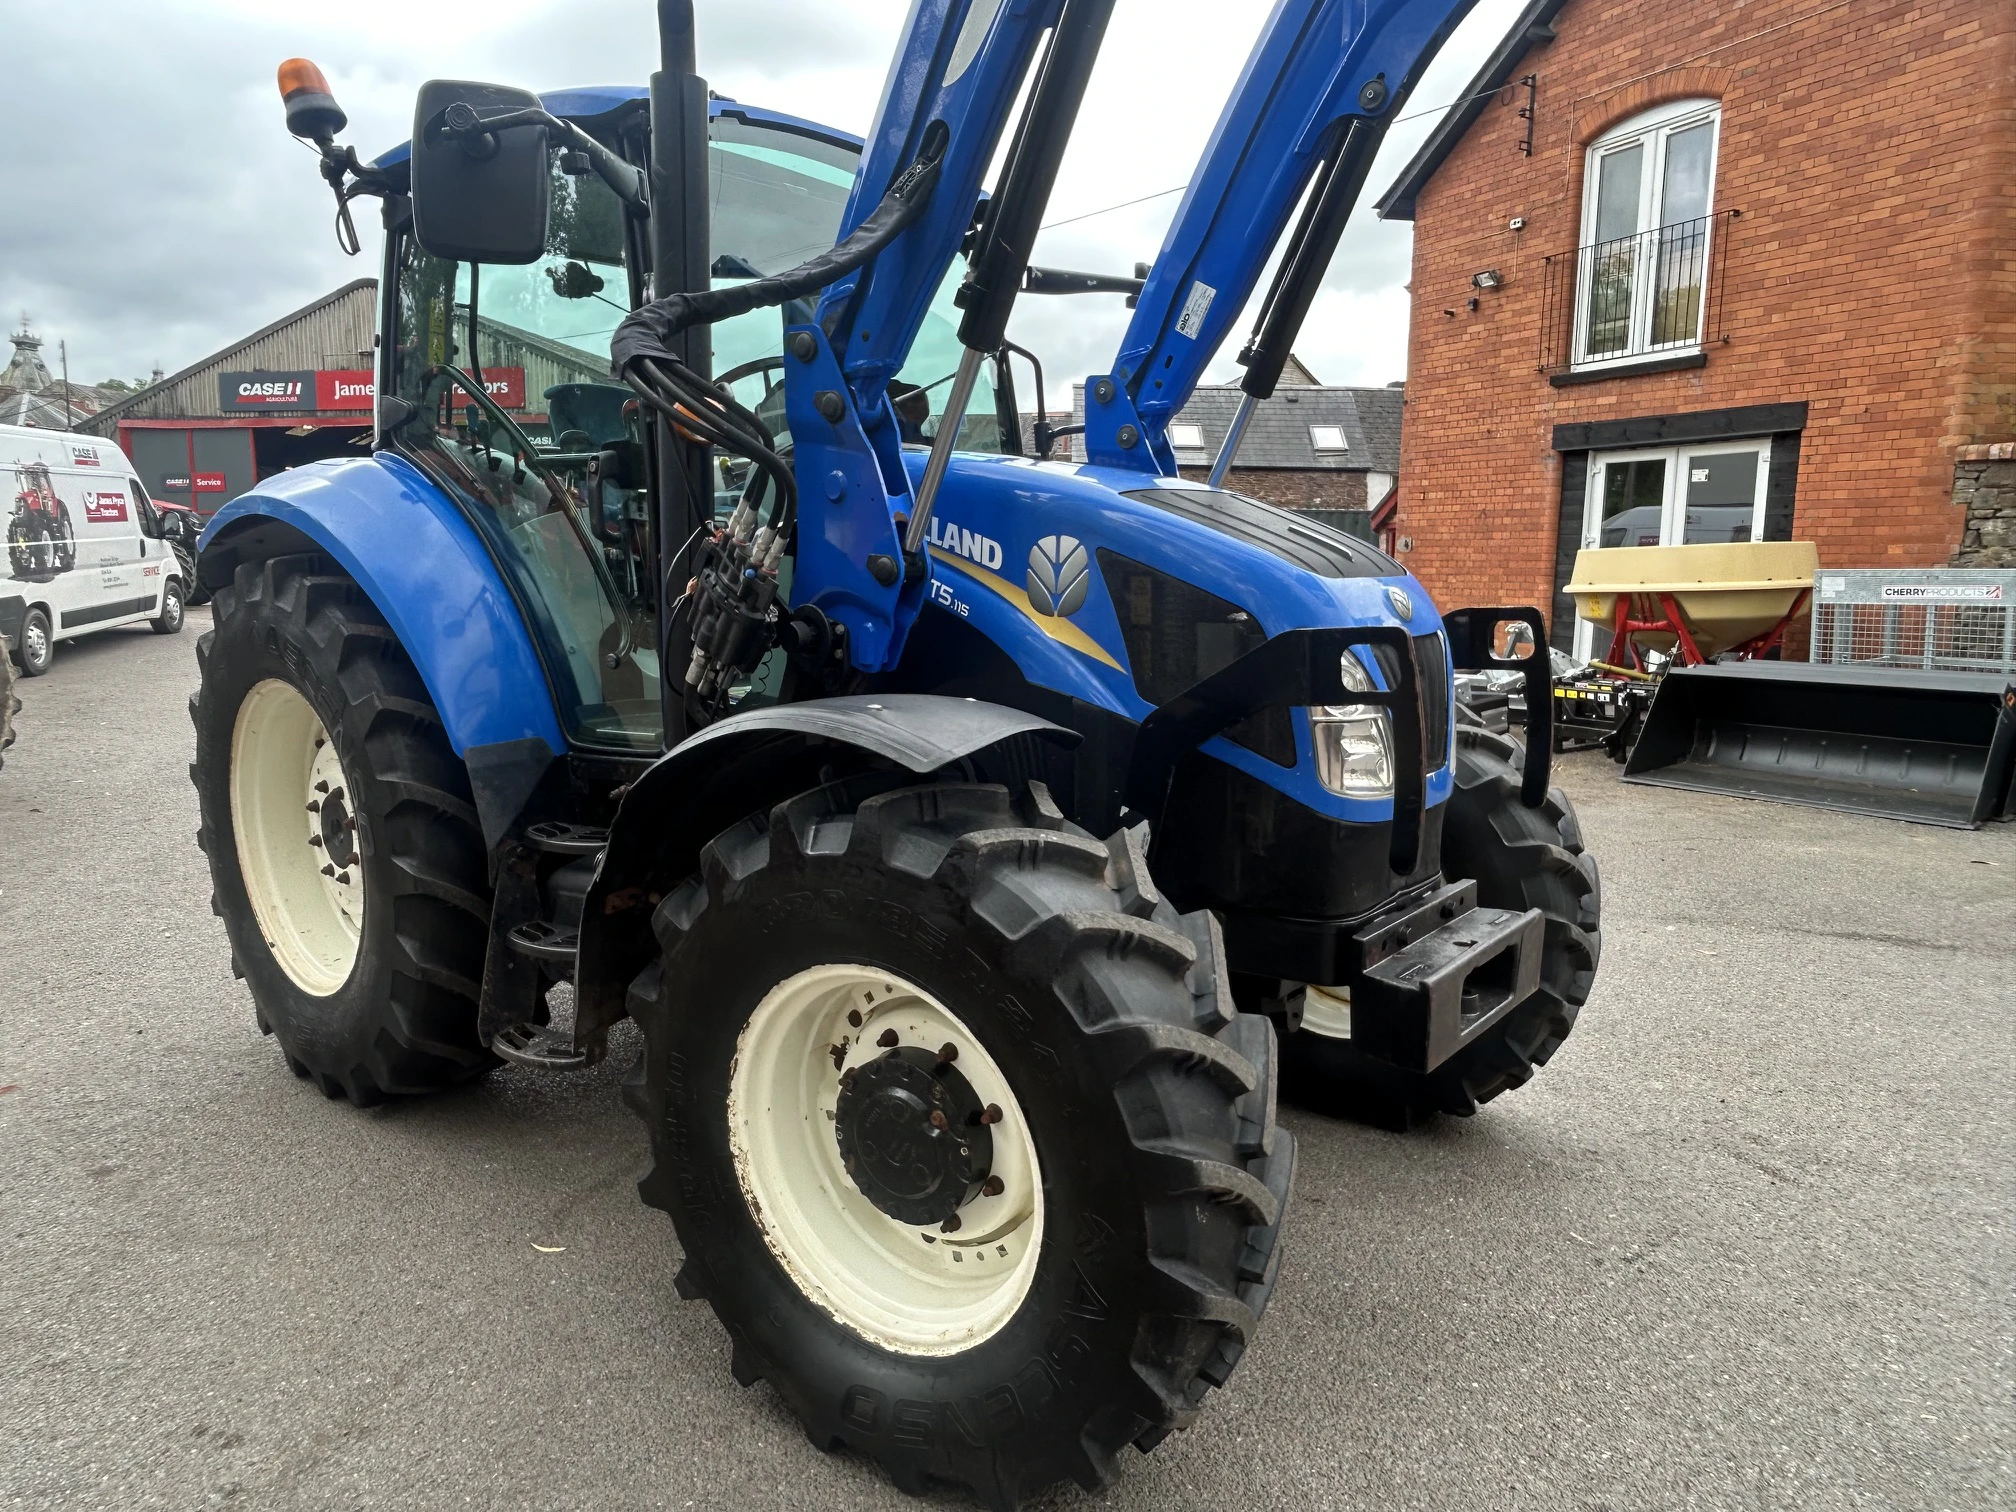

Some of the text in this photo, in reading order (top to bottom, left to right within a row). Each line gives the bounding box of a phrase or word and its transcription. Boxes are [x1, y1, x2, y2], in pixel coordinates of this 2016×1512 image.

[238, 383, 285, 396] CASE
[197, 478, 222, 486] Service
[930, 578, 970, 617] T5.115
[841, 1257, 1110, 1450] ASCENSO
